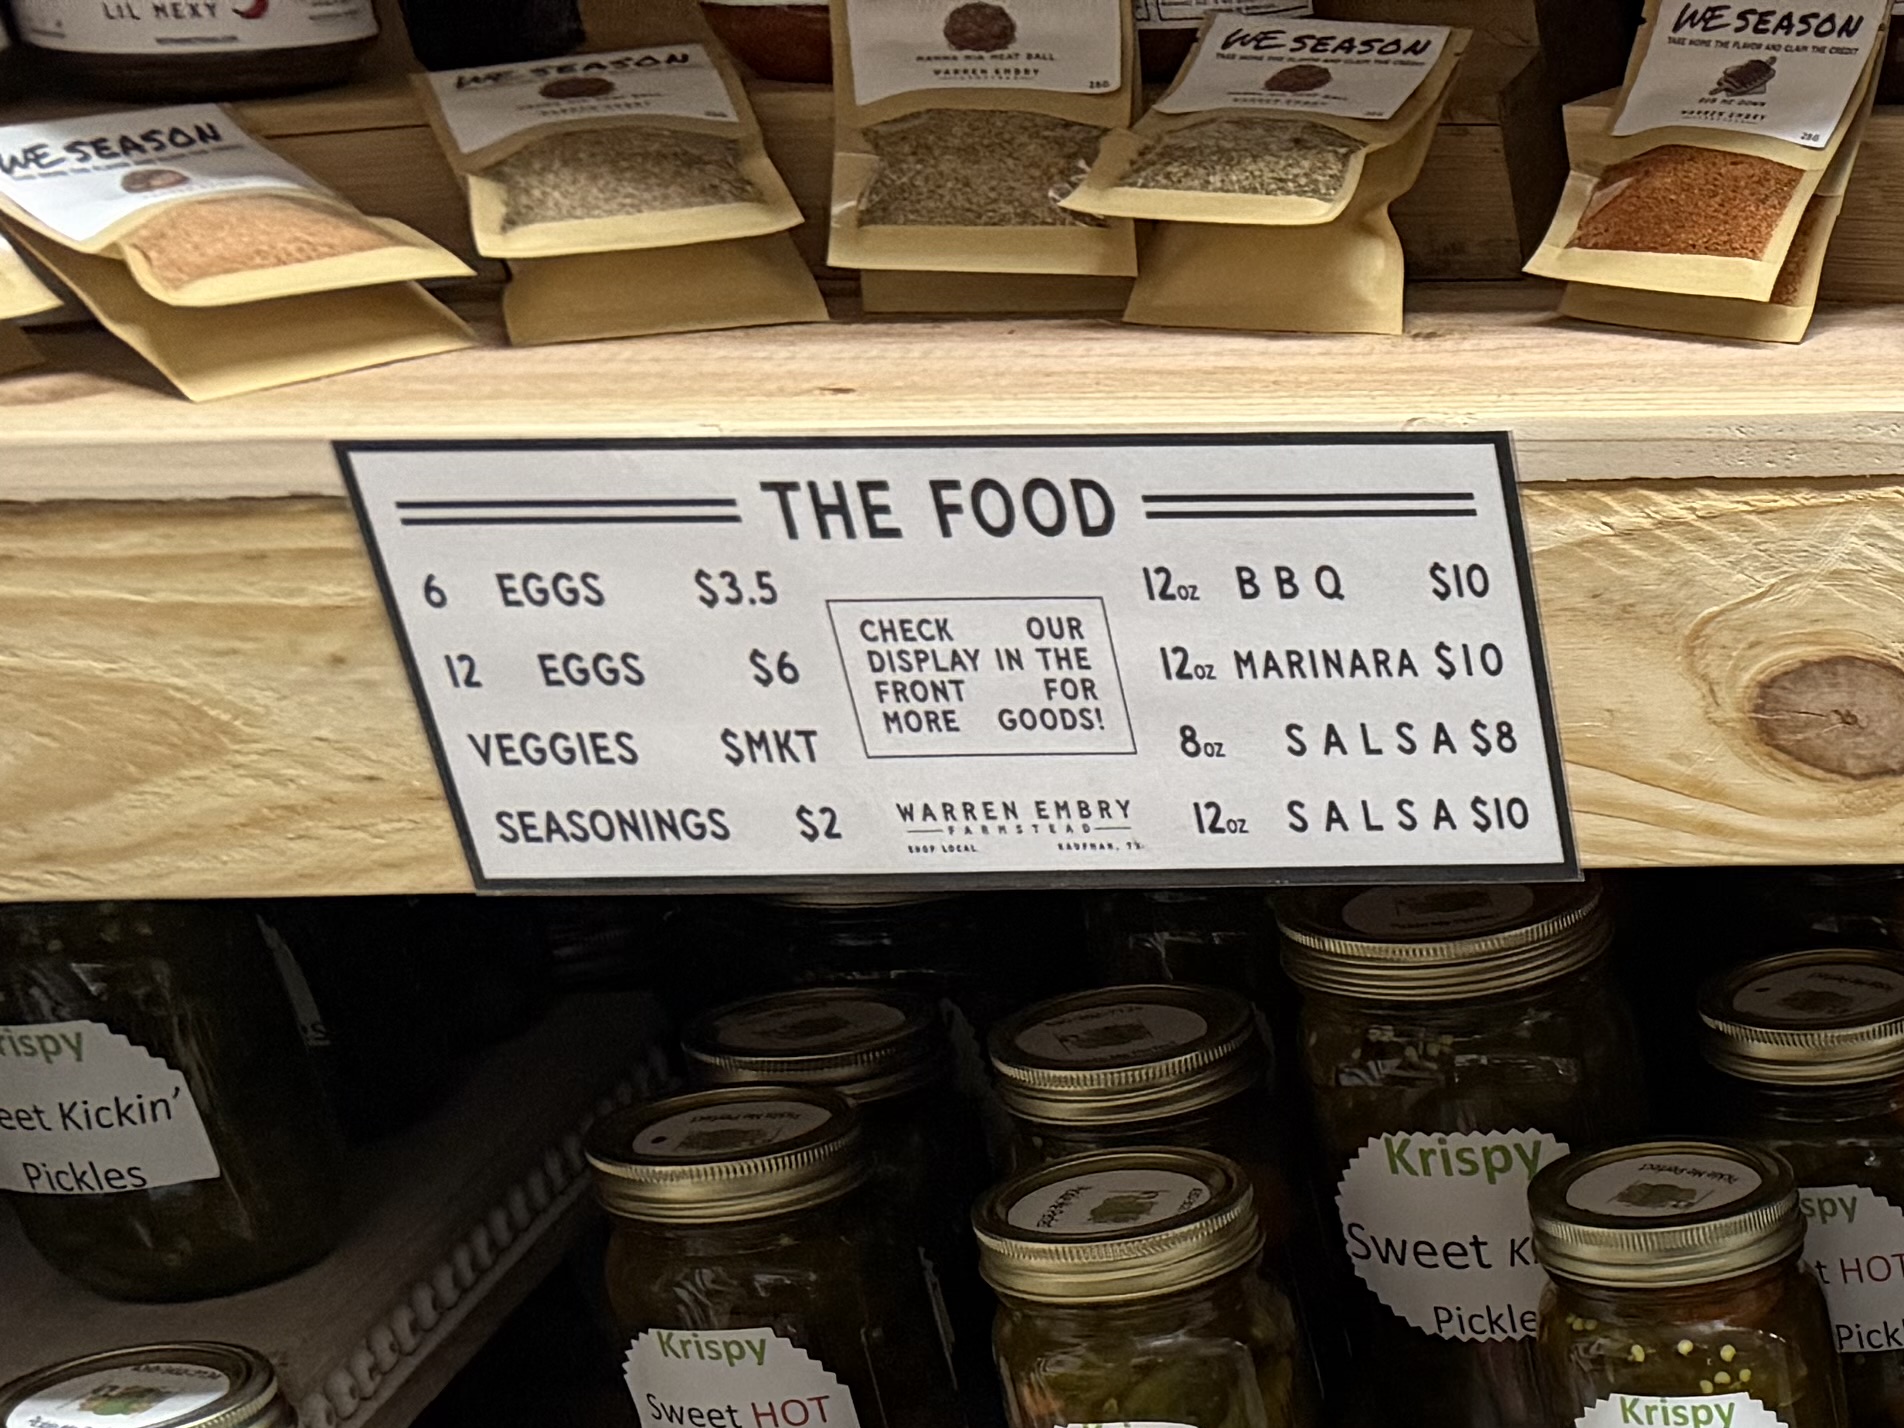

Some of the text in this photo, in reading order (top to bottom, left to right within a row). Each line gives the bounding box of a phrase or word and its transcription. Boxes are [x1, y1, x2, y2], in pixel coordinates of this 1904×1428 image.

[1733, 8, 1864, 38] SEASON
[1289, 34, 1432, 56] SEASON
[63, 122, 224, 164] SEASON
[760, 477, 1116, 540] THE FOOD
[423, 569, 778, 609] 6 EGGS $3.5
[1142, 565, 1200, 601] 12oz
[1429, 561, 1489, 601] $10
[859, 615, 1085, 643] CHECK OUR
[444, 648, 800, 688] 12 EGGS $6
[867, 647, 1092, 674] DISPLAY IN THE
[1160, 641, 1504, 681] 12oz MARINARA $10
[874, 678, 1099, 704] FRONT FOR
[882, 707, 1106, 734] MORE GOODS!
[1179, 718, 1518, 758] 8oz SALSA $8
[467, 727, 819, 767] VEGGIES $MKT
[495, 805, 843, 845] SEASONINGS $2
[896, 799, 1131, 824] WARREN EMBRY
[1192, 795, 1529, 834] 12oz SALSA $10
[22, 1161, 147, 1191] Pickles
[656, 1332, 768, 1366] Krispy
[750, 1395, 831, 1428] HOT
